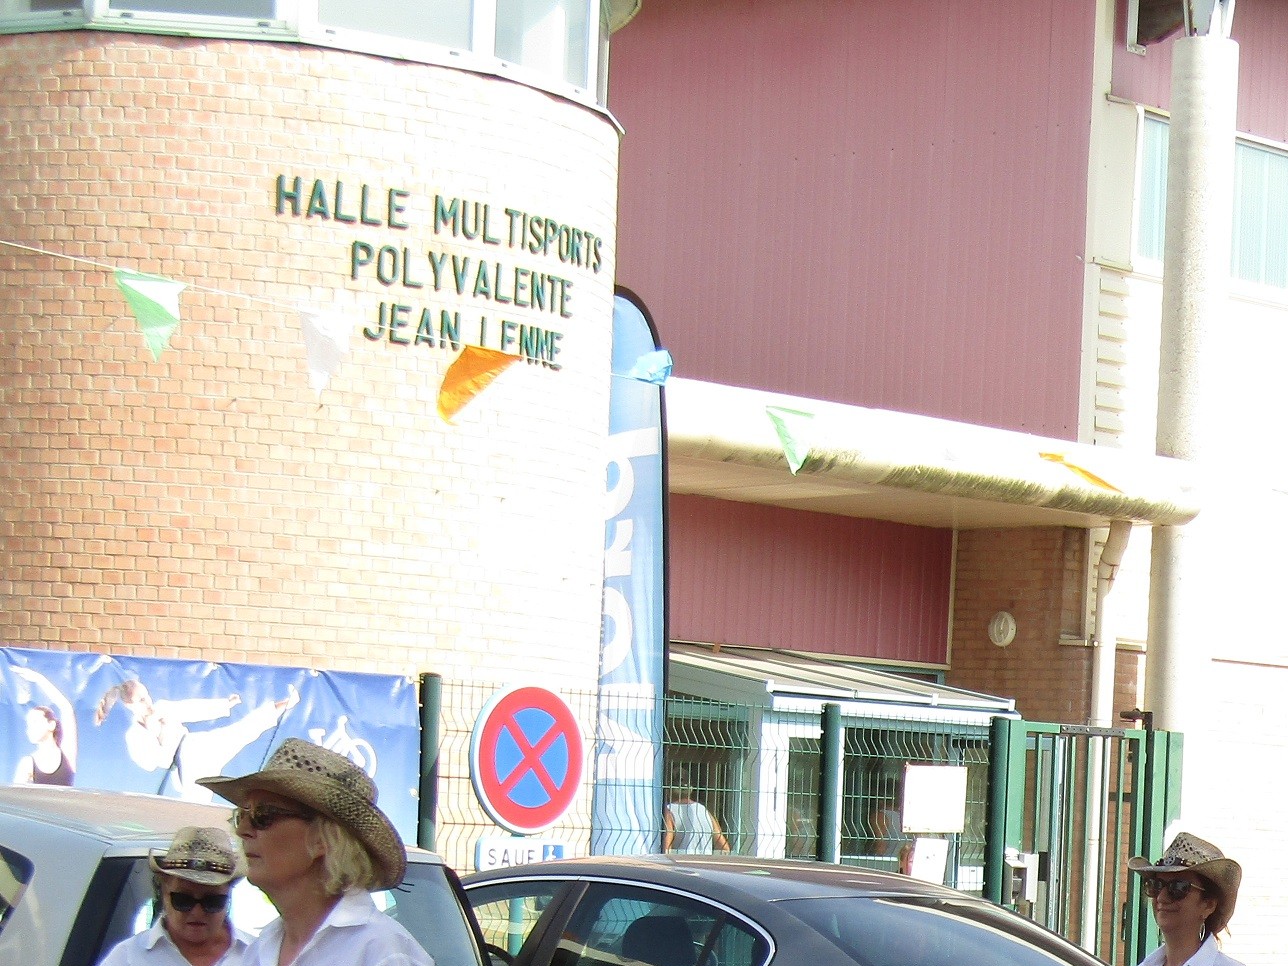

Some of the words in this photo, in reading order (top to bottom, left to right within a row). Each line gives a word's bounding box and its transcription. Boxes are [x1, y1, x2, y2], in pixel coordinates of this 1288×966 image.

[275, 174, 411, 231] HALLE
[433, 194, 603, 274] MULTISPORTS
[351, 240, 575, 319] POLYVALENTE
[363, 301, 462, 351] JEAN
[487, 848, 536, 868] SAUF
